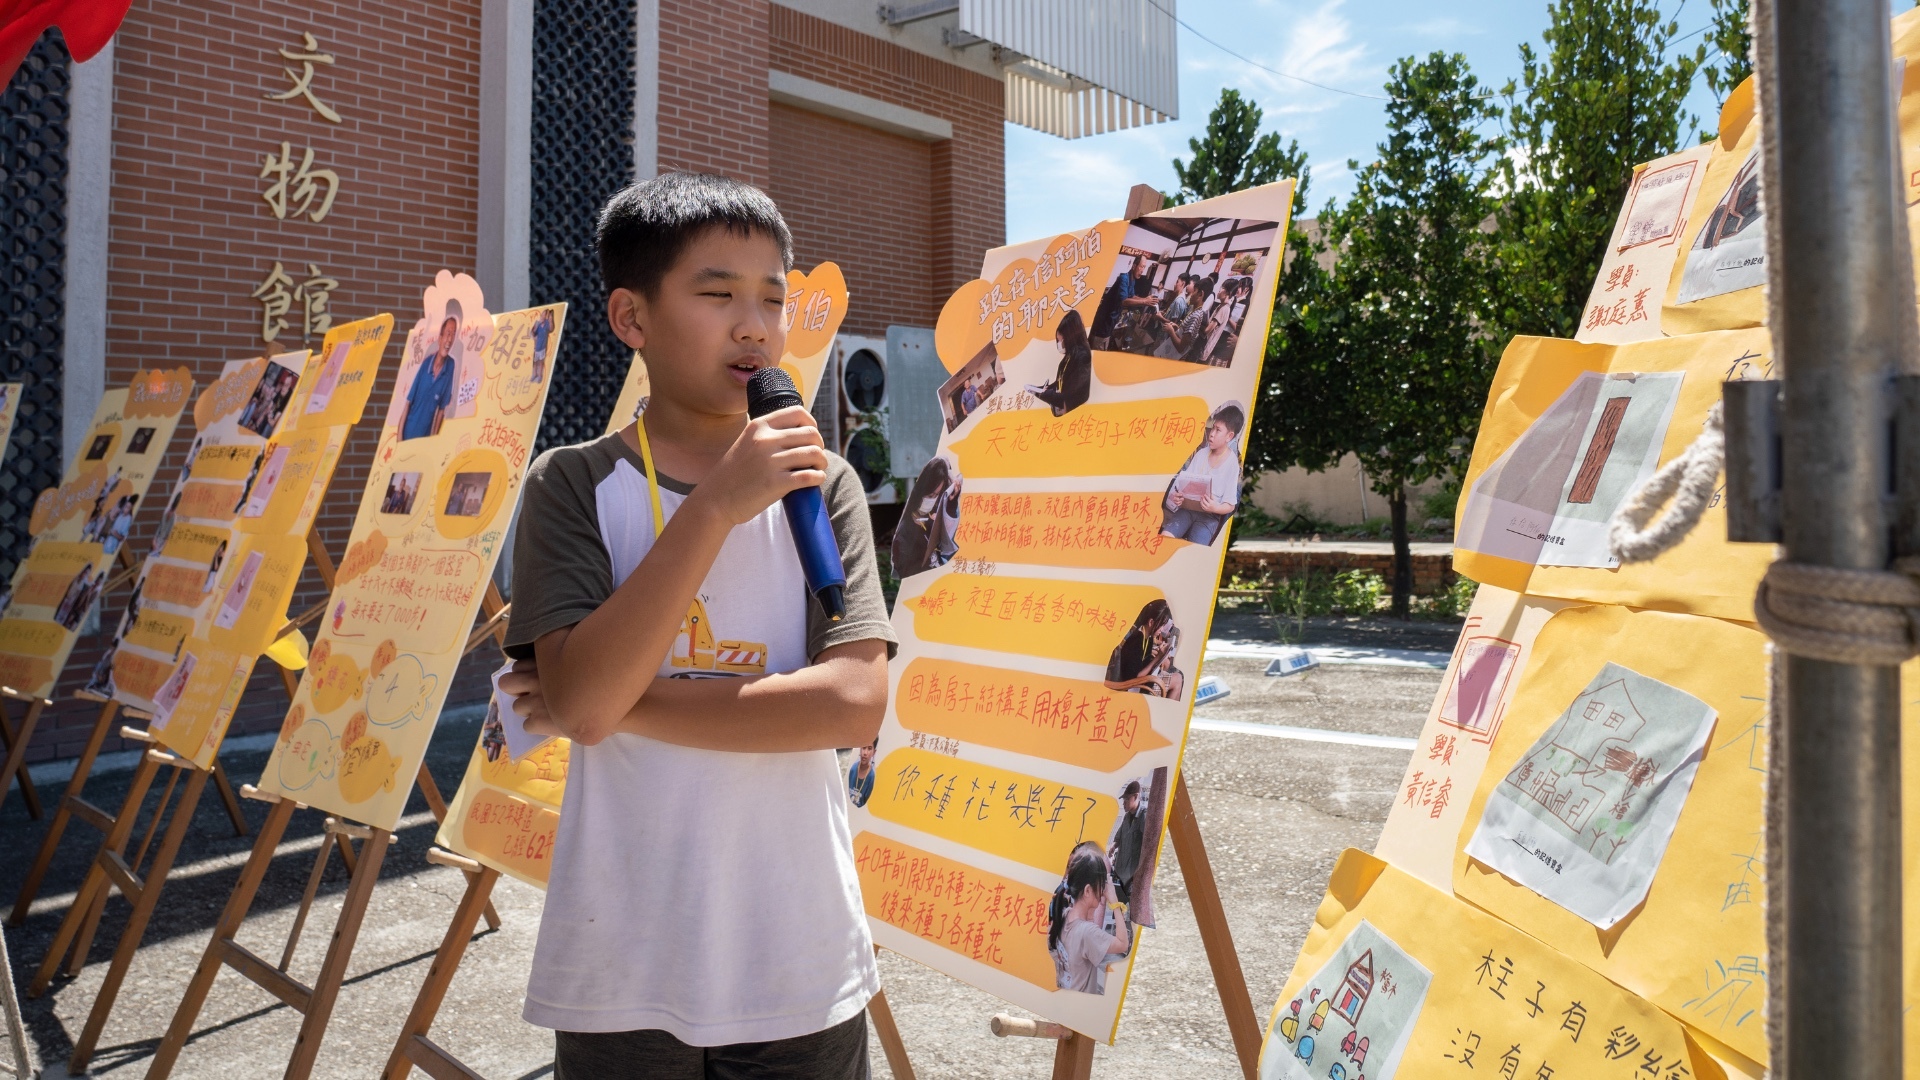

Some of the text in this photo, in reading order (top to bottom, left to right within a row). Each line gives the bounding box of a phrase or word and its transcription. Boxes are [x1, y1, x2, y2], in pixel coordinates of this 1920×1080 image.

[251, 31, 342, 343] 文物館
[978, 228, 1101, 325] 跟存信阿伯
[991, 266, 1095, 345] 的聊天室
[893, 764, 1096, 844] 你種花幾年了
[856, 844, 1051, 935] 40年前開始種沙漠玫瑰
[880, 890, 1003, 964] 後來種了各種花
